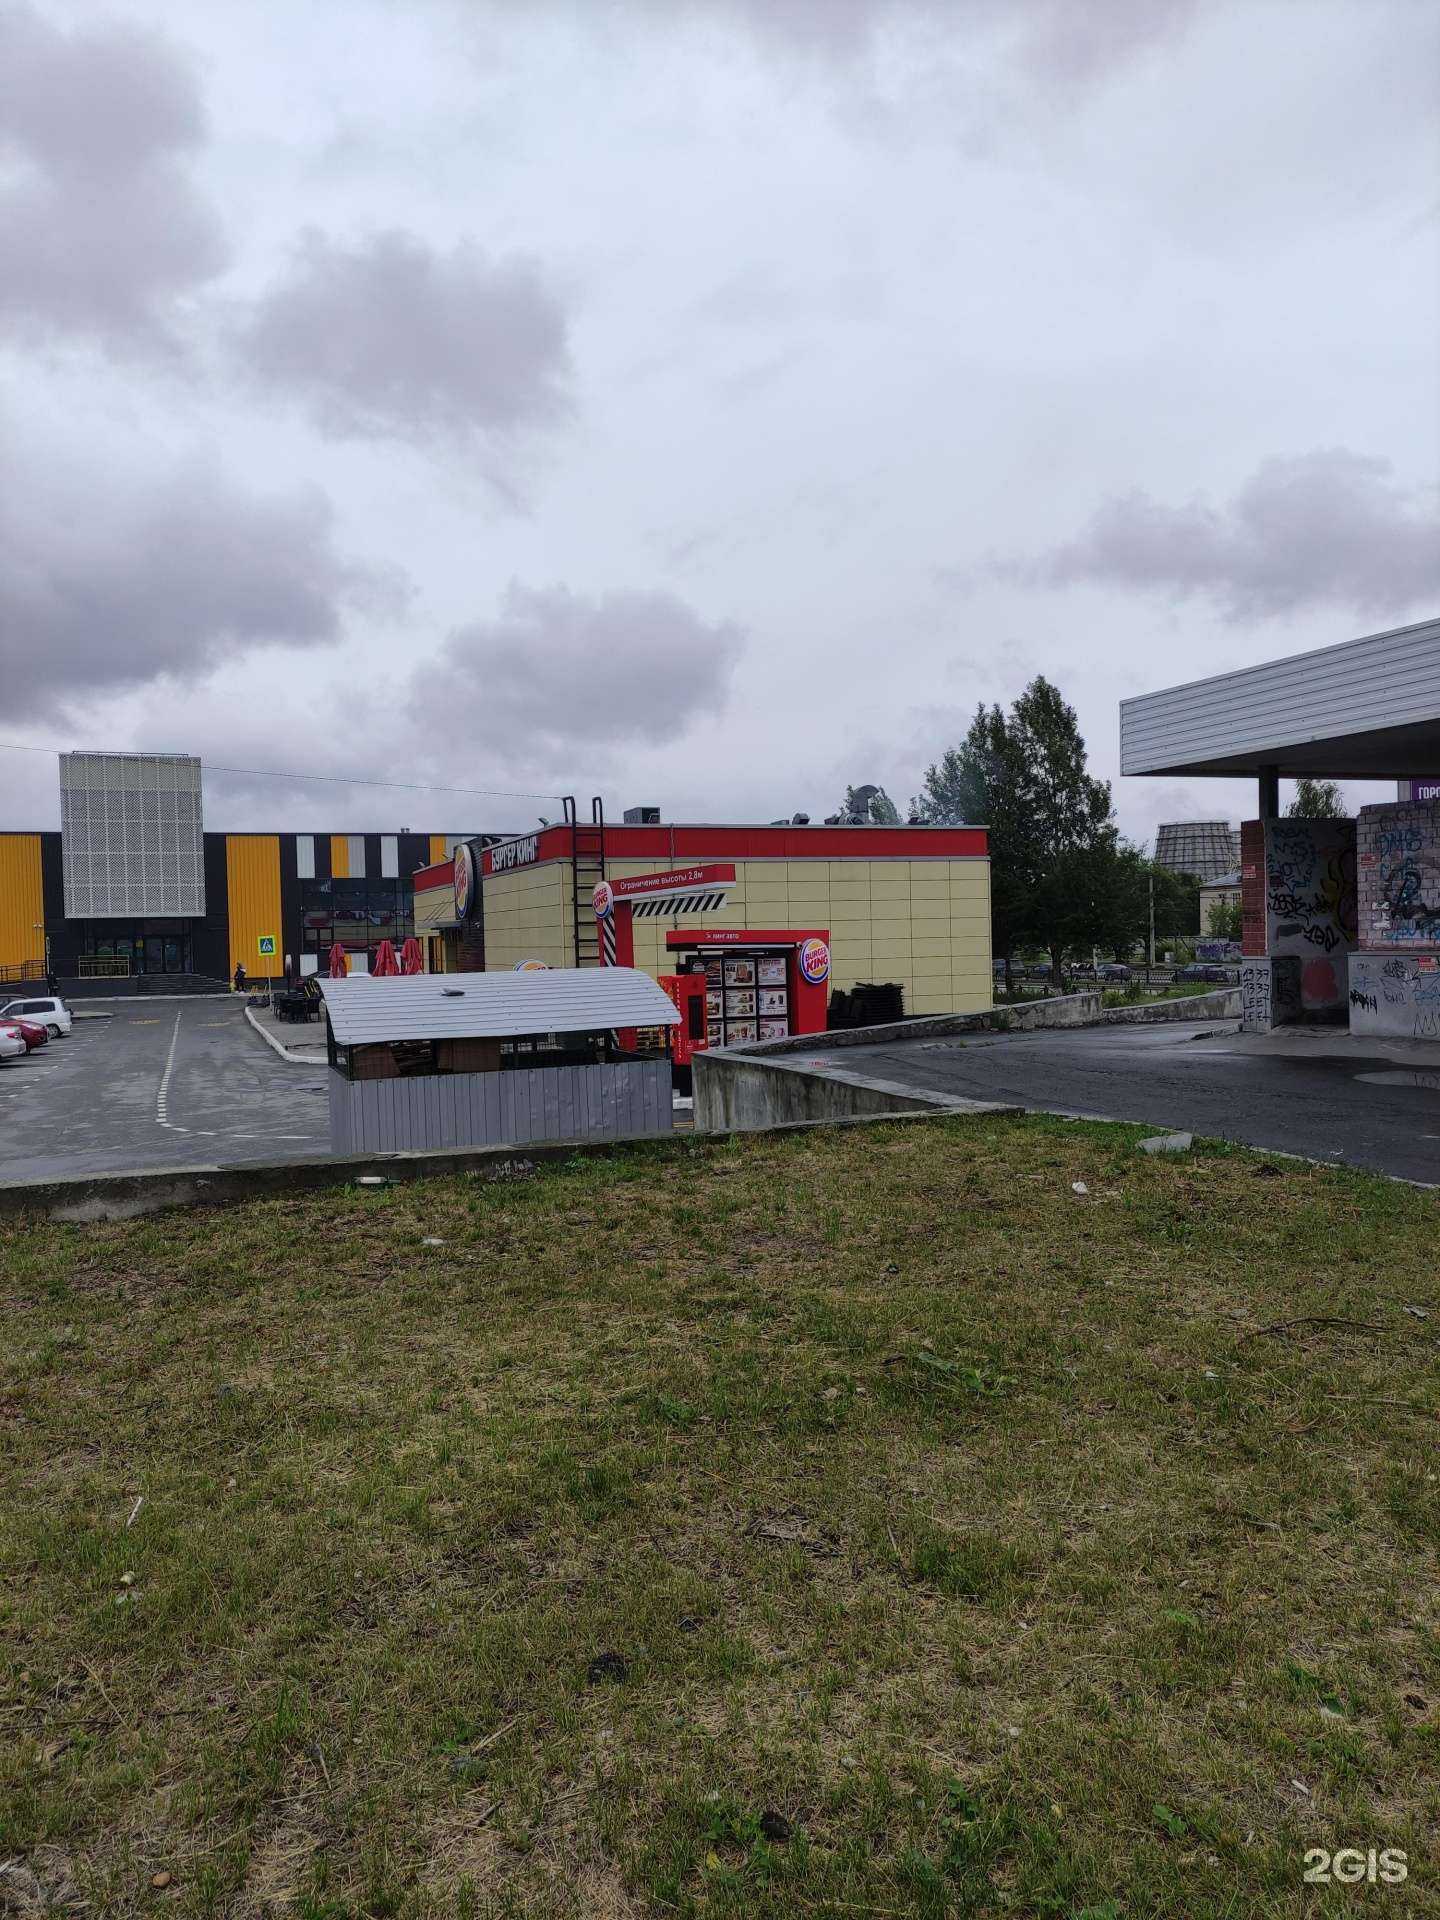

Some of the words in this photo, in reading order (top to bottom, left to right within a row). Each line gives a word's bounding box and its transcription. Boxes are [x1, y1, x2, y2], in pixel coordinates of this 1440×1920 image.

[491, 843, 516, 872] БУРГЕР
[516, 836, 537, 866] КИНГ
[620, 878, 660, 891] Ограничение
[661, 874, 687, 885] высоты
[688, 870, 703, 881] 2,8м
[805, 946, 826, 962] BURGER
[806, 954, 828, 973] KING
